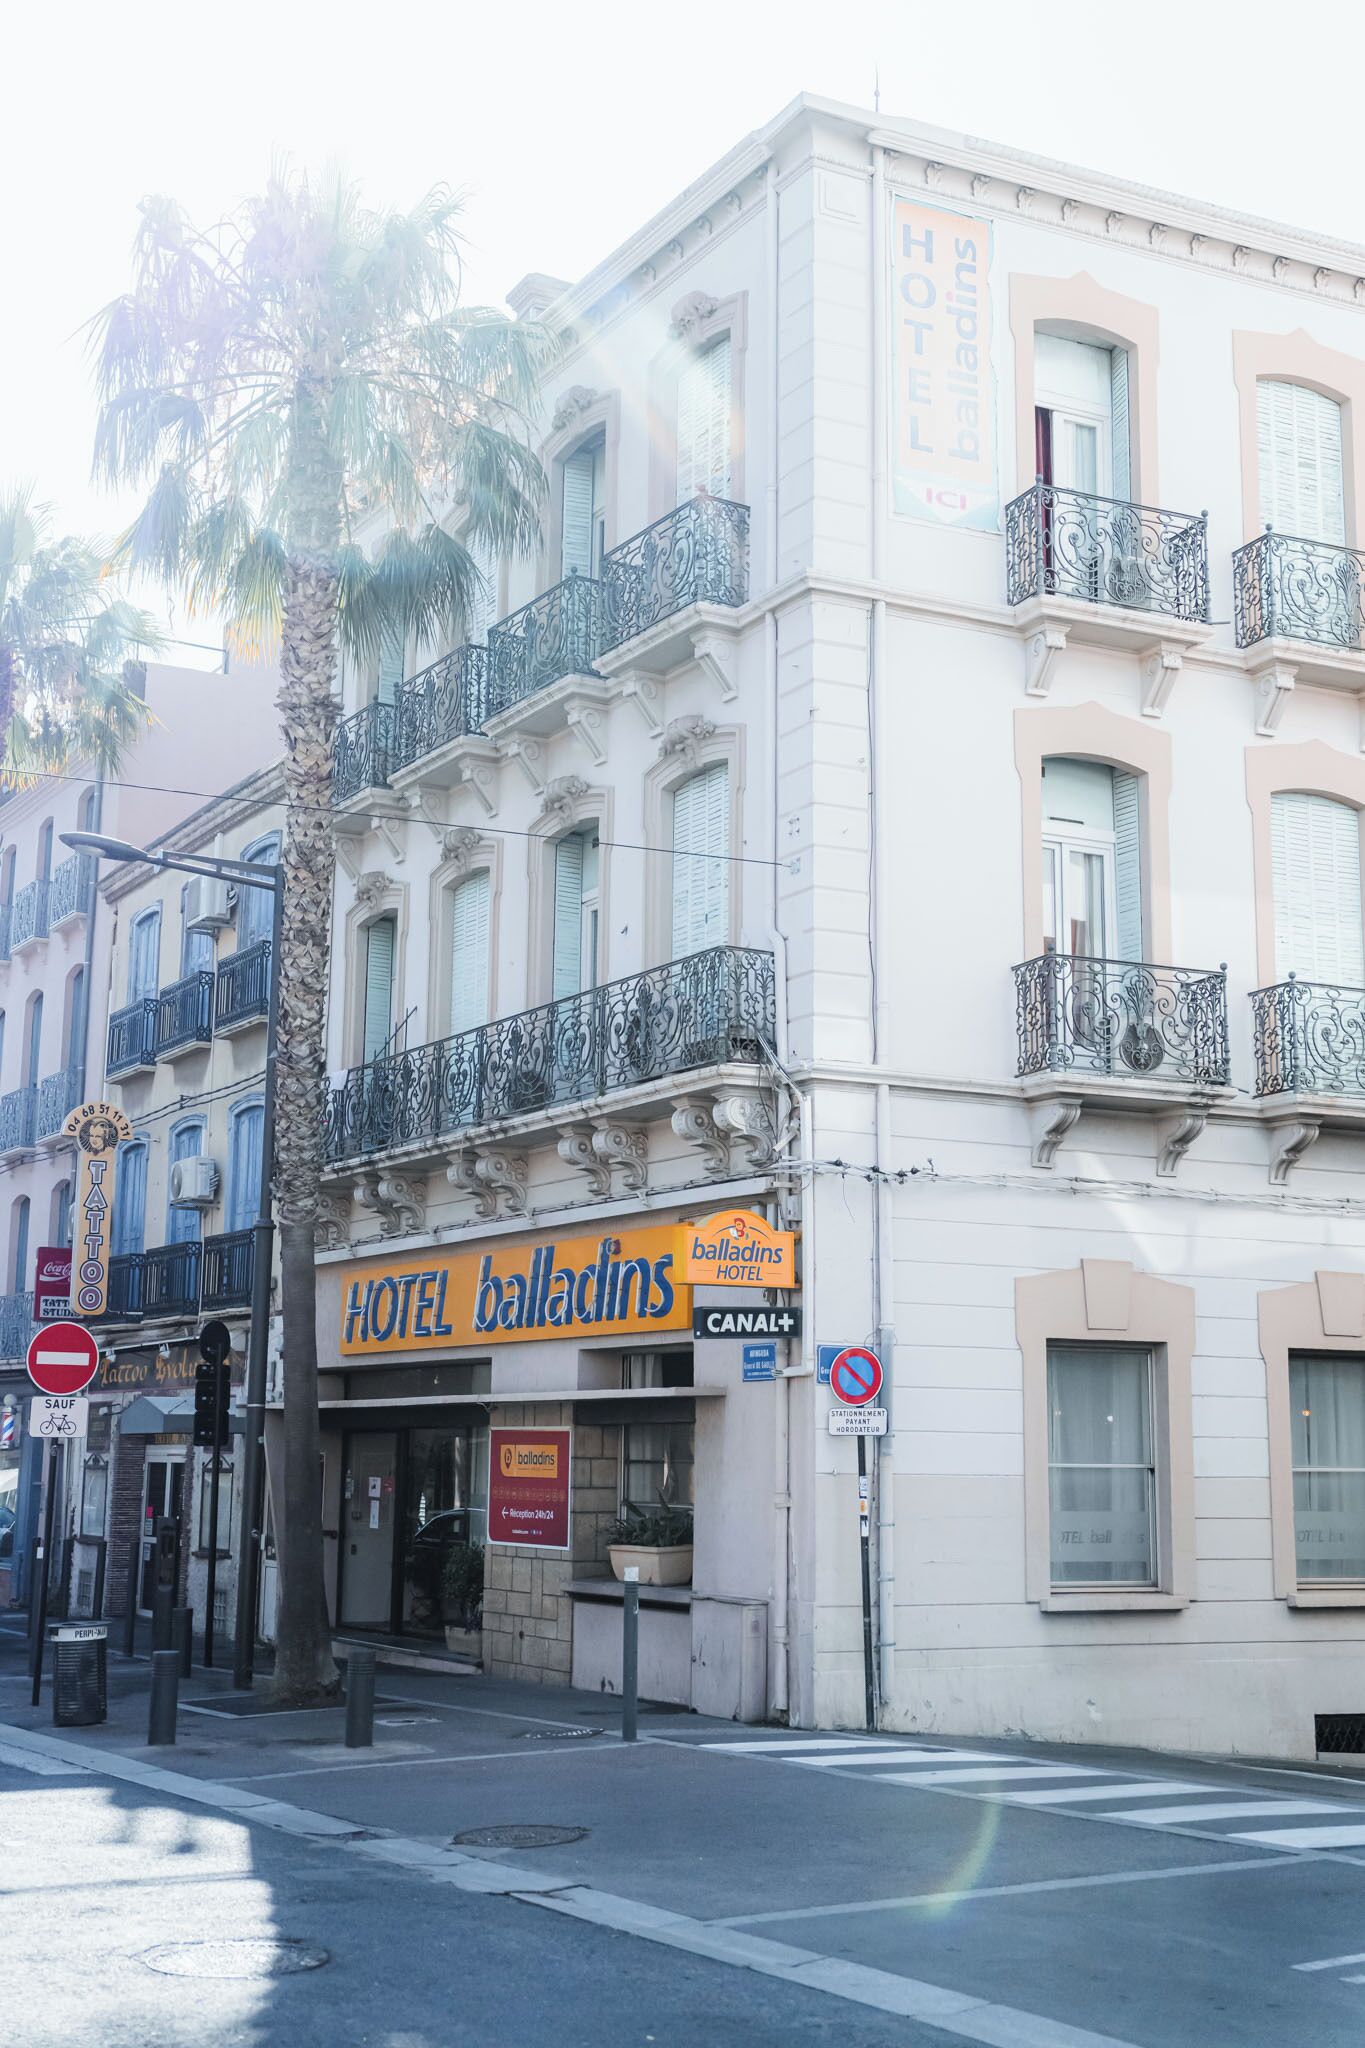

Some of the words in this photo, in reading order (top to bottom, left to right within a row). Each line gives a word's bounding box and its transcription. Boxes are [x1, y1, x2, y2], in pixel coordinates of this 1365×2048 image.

[900, 223, 936, 453] HOTEL
[946, 235, 980, 462] balladins
[926, 488, 966, 511] ICI
[68, 1116, 81, 1132] 04
[82, 1105, 95, 1117] 68
[99, 1104, 110, 1115] 51
[113, 1111, 123, 1122] 11
[120, 1123, 130, 1136] 31
[78, 1160, 107, 1311] TATTOO
[691, 1236, 783, 1264] balladins
[43, 1261, 72, 1277] Coca-C
[716, 1265, 763, 1281] HOTEL
[342, 1269, 453, 1344] HOTEL
[472, 1237, 674, 1333] balladins
[42, 1298, 72, 1308] TATT
[707, 1313, 794, 1333] CANAL+
[101, 1358, 148, 1387] Tattoo
[155, 1347, 220, 1384] Evolu
[45, 1399, 76, 1409] SAUF
[518, 1450, 555, 1466] balladins
[75, 1627, 106, 1638] PERPI
